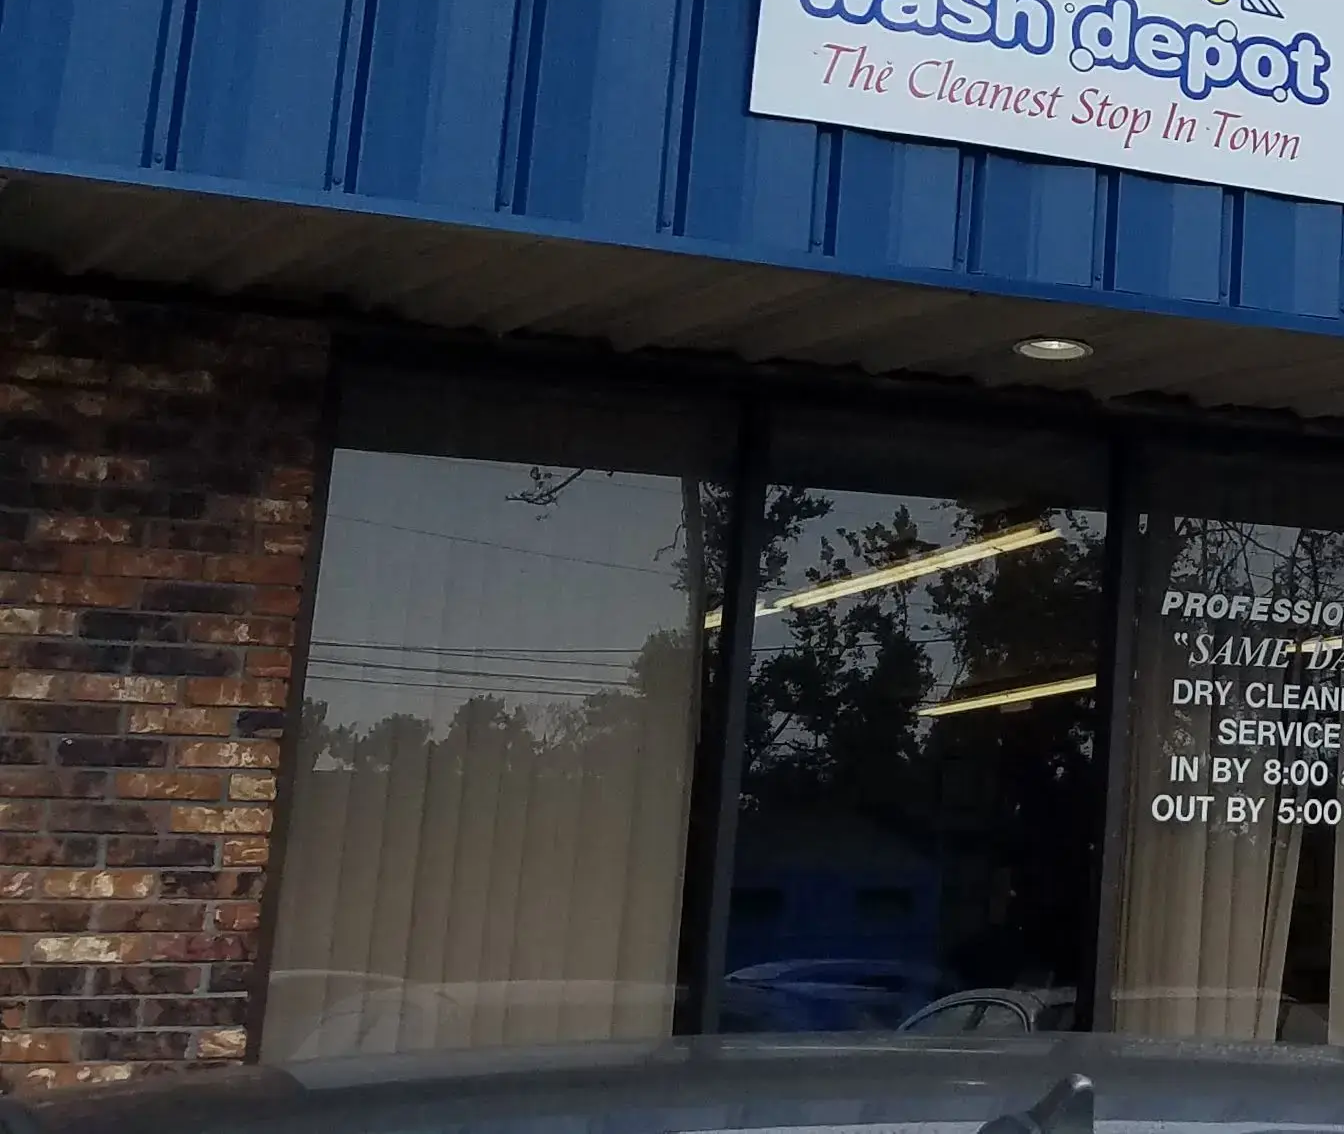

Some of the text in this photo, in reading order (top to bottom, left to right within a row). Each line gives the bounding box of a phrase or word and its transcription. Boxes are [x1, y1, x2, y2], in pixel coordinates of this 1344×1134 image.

[822, 43, 1300, 161] The Cleanest Stop In Town
[1172, 679, 1233, 706] DRY
[1217, 718, 1341, 749] SERVICE
[1170, 756, 1199, 782] IN
[1212, 757, 1251, 784] BY
[1263, 759, 1329, 787] 8:00
[1152, 795, 1214, 823] OUT
[1226, 797, 1265, 823] BY
[1277, 798, 1342, 825] 5:00
